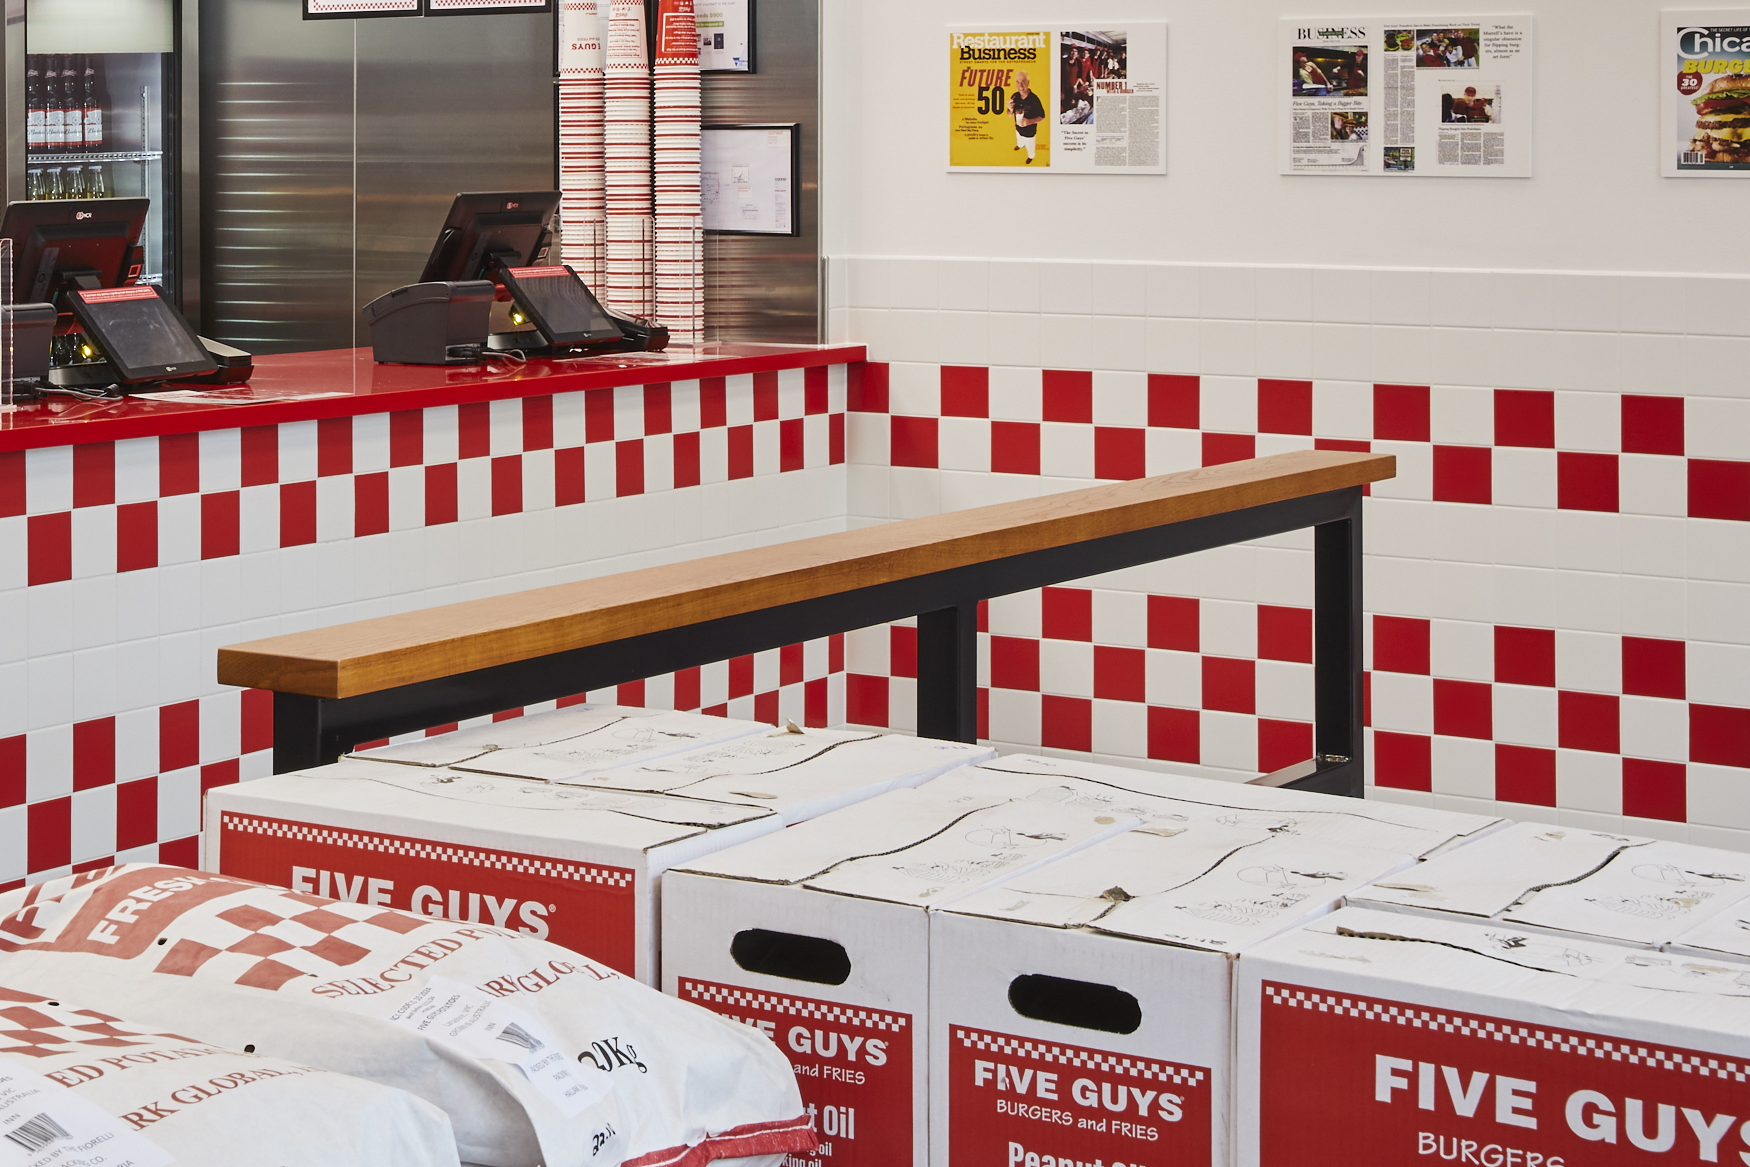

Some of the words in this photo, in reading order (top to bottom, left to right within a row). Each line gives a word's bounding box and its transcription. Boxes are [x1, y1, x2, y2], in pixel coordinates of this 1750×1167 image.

[952, 32, 1046, 49] Restaurant
[959, 45, 1037, 61] Business
[959, 69, 1014, 88] FUTURE
[1681, 78, 1698, 87] 30
[977, 86, 1005, 115] 50
[823, 1065, 866, 1085] FRIES
[974, 1059, 1059, 1101] FIVE
[996, 1099, 1073, 1126] BURGERS
[1077, 1116, 1107, 1133] and
[1111, 1120, 1159, 1142] FRIES
[1375, 1053, 1538, 1130] FIVE
[1565, 1089, 1750, 1167] GUY
[823, 1105, 855, 1140] Oil
